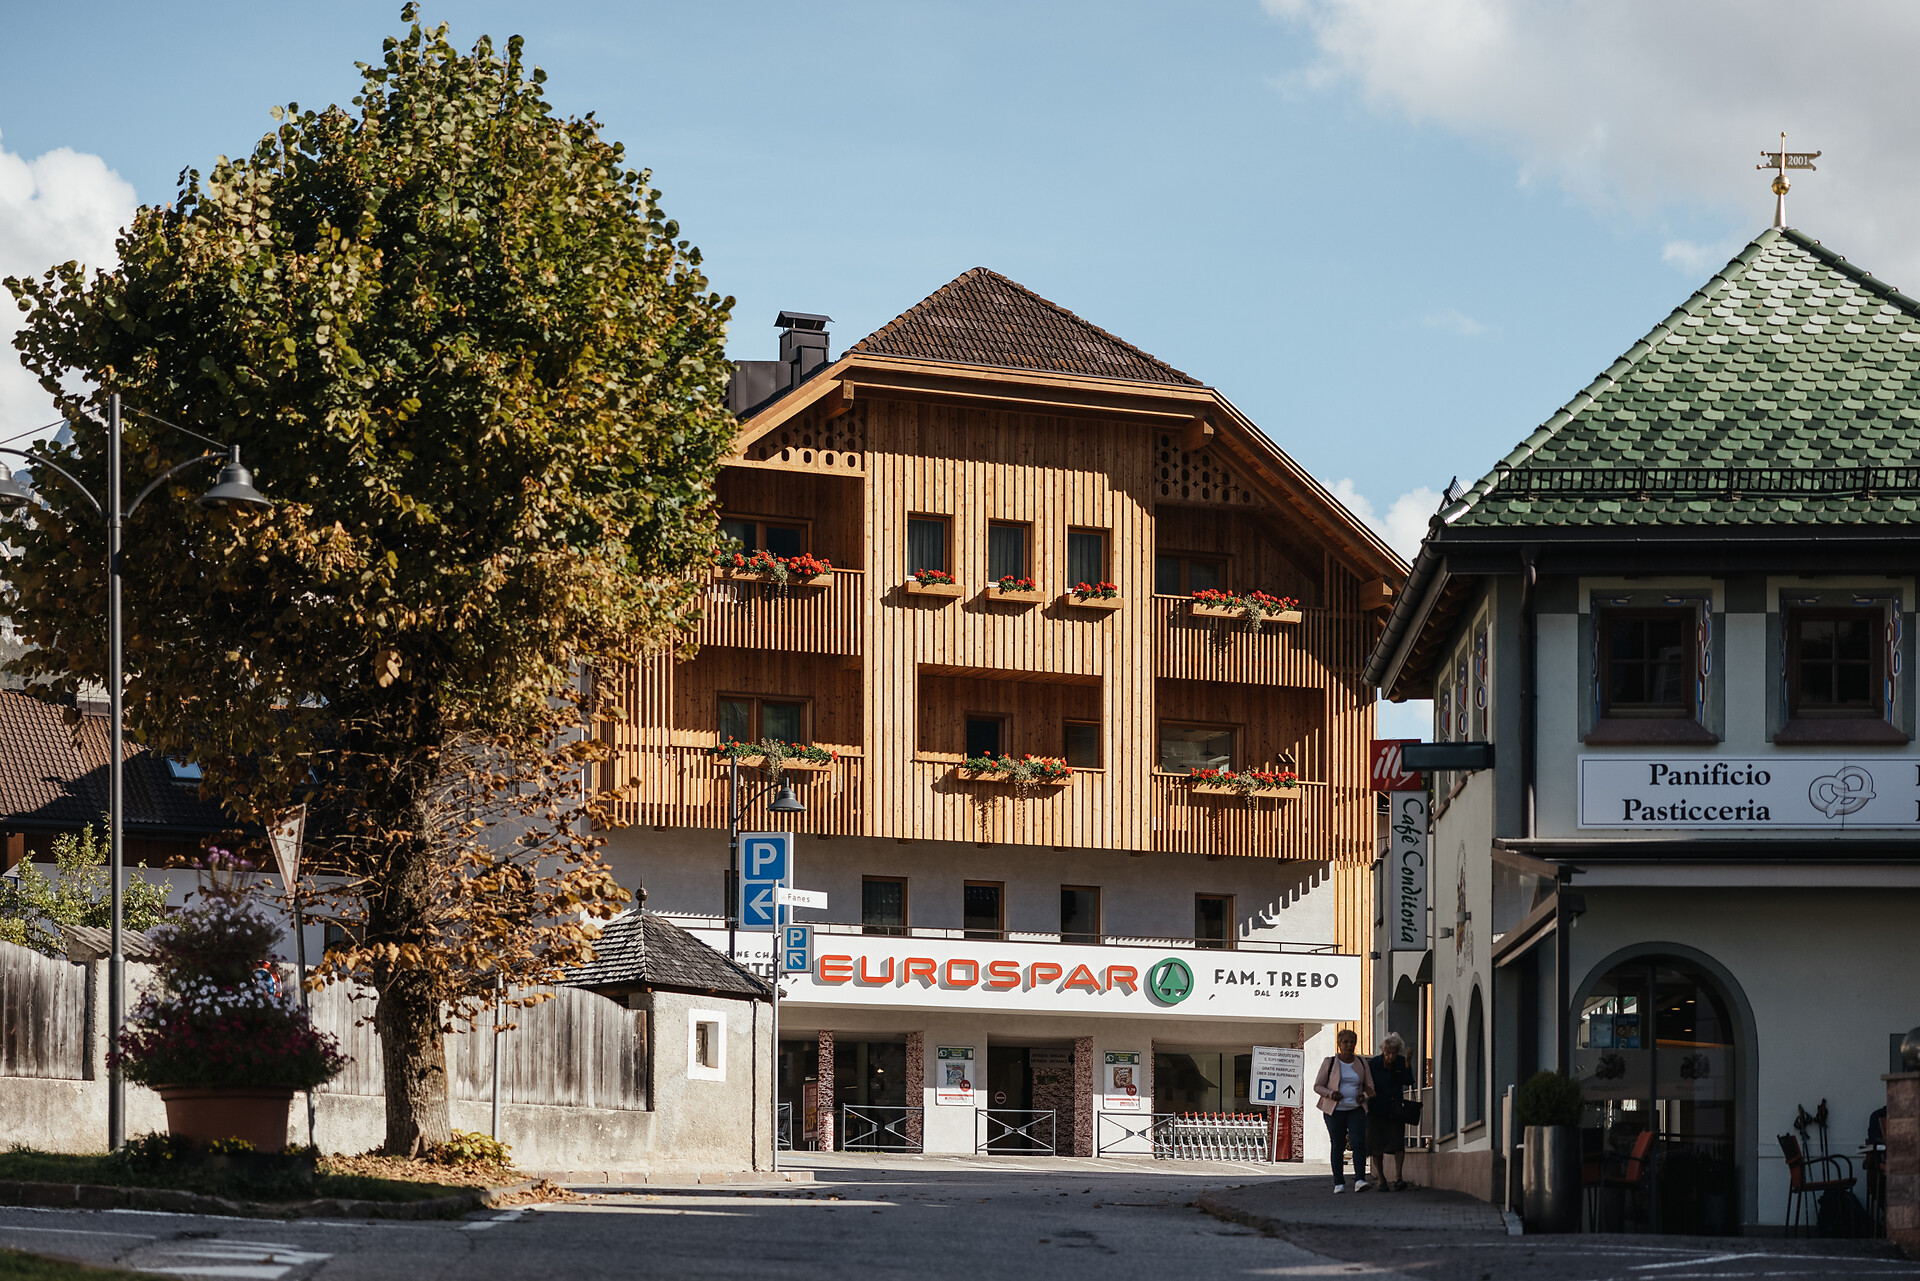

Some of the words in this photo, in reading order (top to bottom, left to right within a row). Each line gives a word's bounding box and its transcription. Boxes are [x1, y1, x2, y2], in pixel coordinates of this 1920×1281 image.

[1787, 155, 1808, 166] 2001
[1649, 763, 1771, 786] Panificio
[1622, 798, 1771, 821] Pasticceria
[753, 843, 777, 875] P
[787, 893, 811, 903] Fanes
[1401, 850, 1424, 943] Conditoria
[790, 929, 803, 946] P
[819, 954, 1139, 992] EUROSPAR
[1214, 969, 1261, 986] FAM.
[1266, 971, 1339, 988] TREBO
[1254, 989, 1271, 997] DAL
[1261, 1081, 1274, 1099] P
